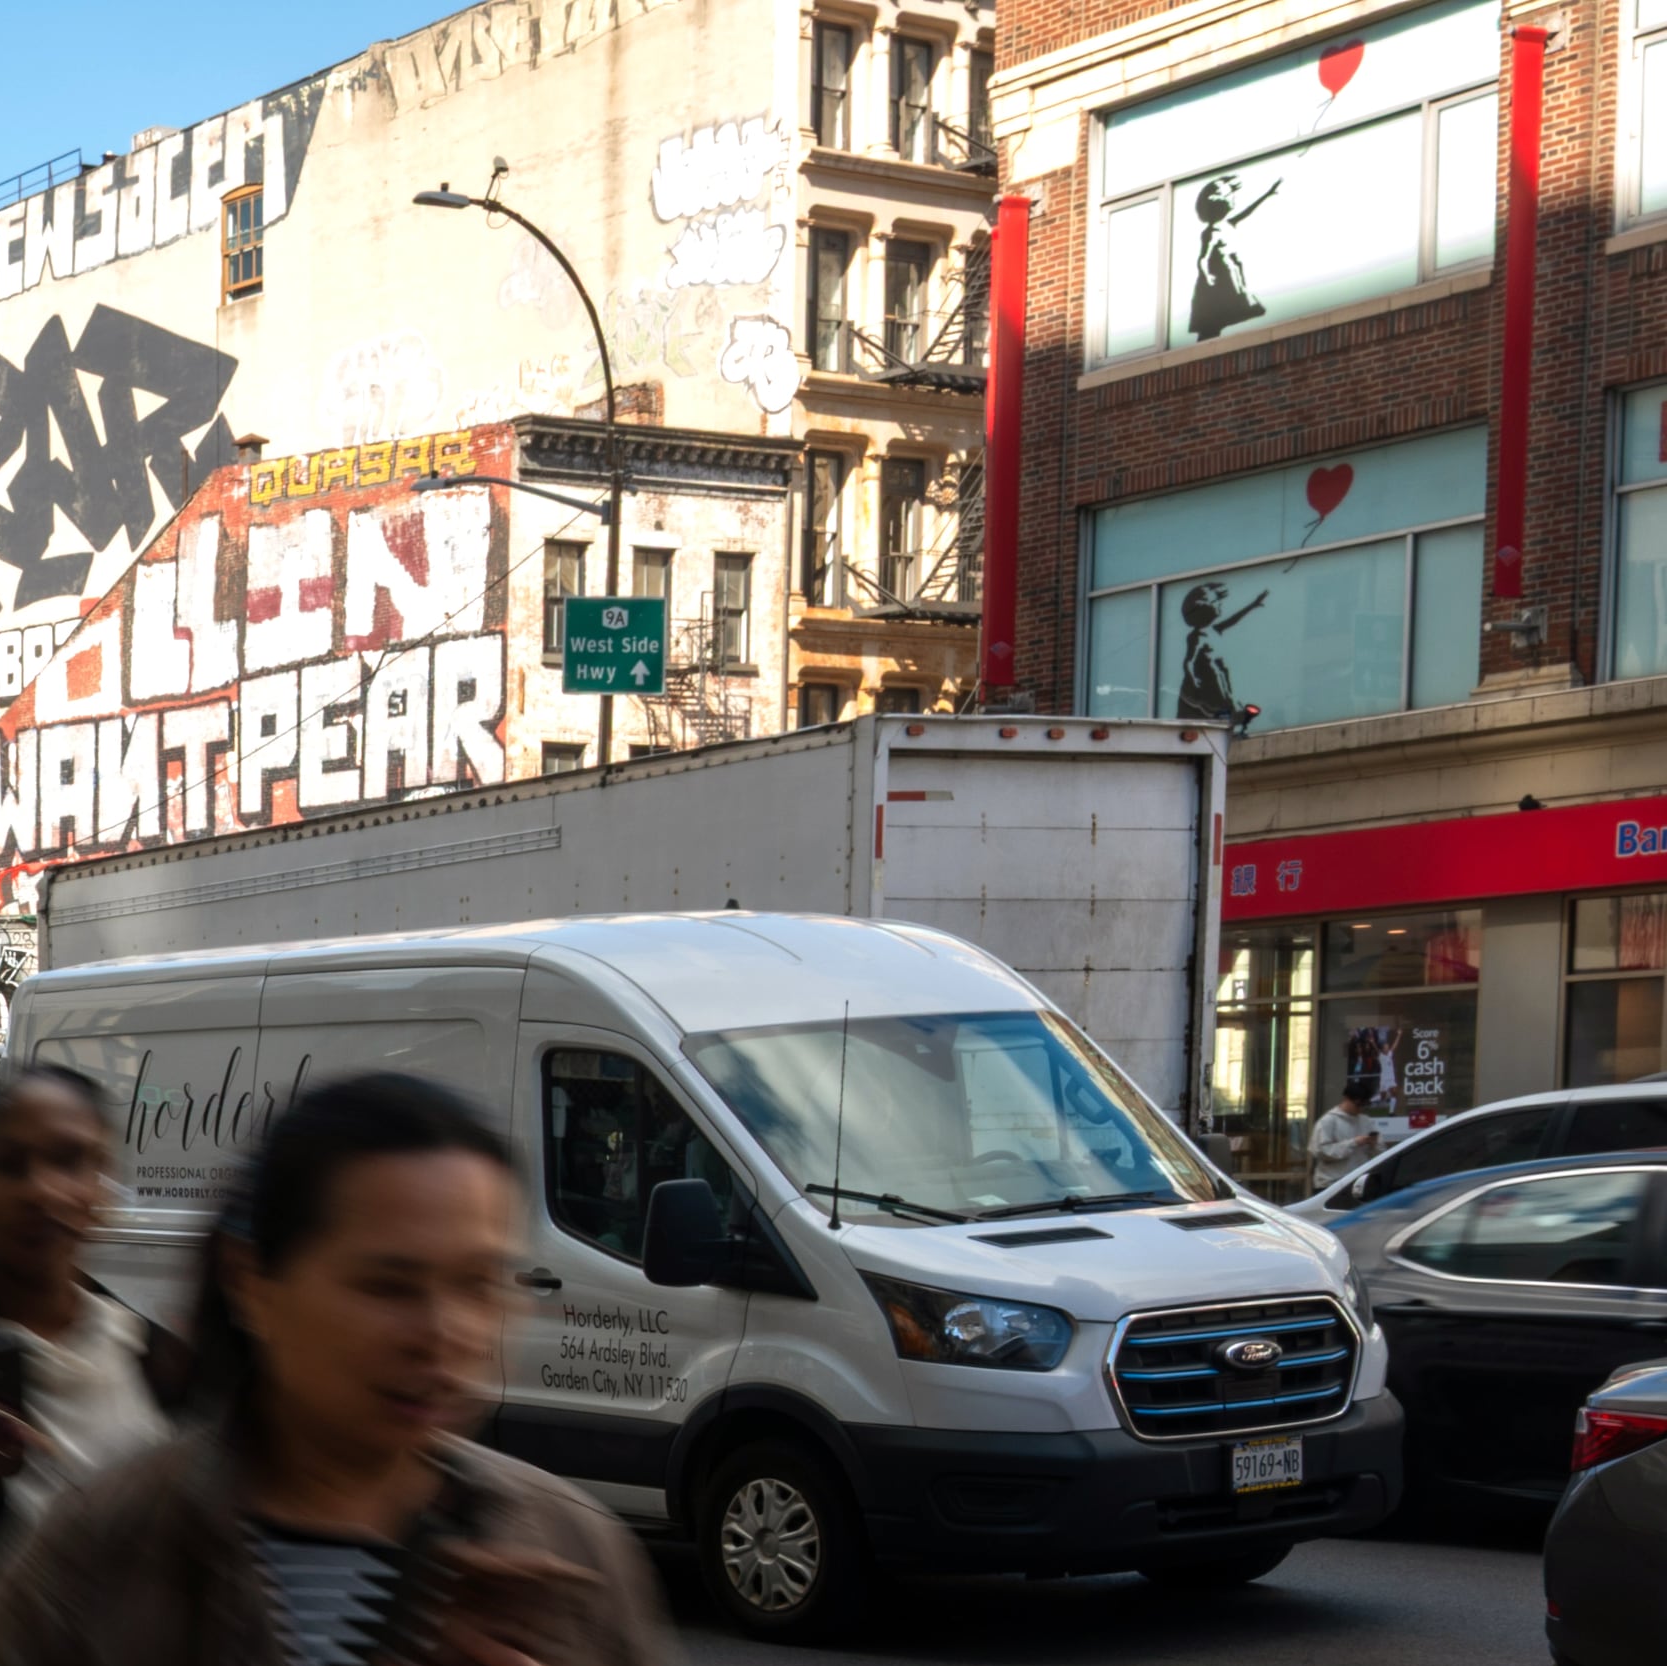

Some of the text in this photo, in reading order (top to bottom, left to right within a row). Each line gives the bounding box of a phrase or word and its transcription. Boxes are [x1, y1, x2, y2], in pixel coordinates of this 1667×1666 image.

[605, 610, 626, 627] 9A
[570, 636, 660, 654] West Side
[576, 663, 617, 684] Hwy
[239, 632, 512, 818] PEAR
[1411, 1028, 1440, 1039] Score
[1404, 1056, 1445, 1076] cash
[1403, 1076, 1444, 1096] back
[124, 1045, 313, 1154] horderl
[136, 1165, 208, 1181] PROFESSIONAL
[136, 1185, 231, 1200] WWW.HORDERLY.CO
[563, 1305, 670, 1337] Horderly, LLC
[559, 1335, 671, 1370] 564 Ardsley Blvd.
[540, 1363, 688, 1403] Garden City, NY 11530
[1235, 1448, 1300, 1482] 59169 NB
